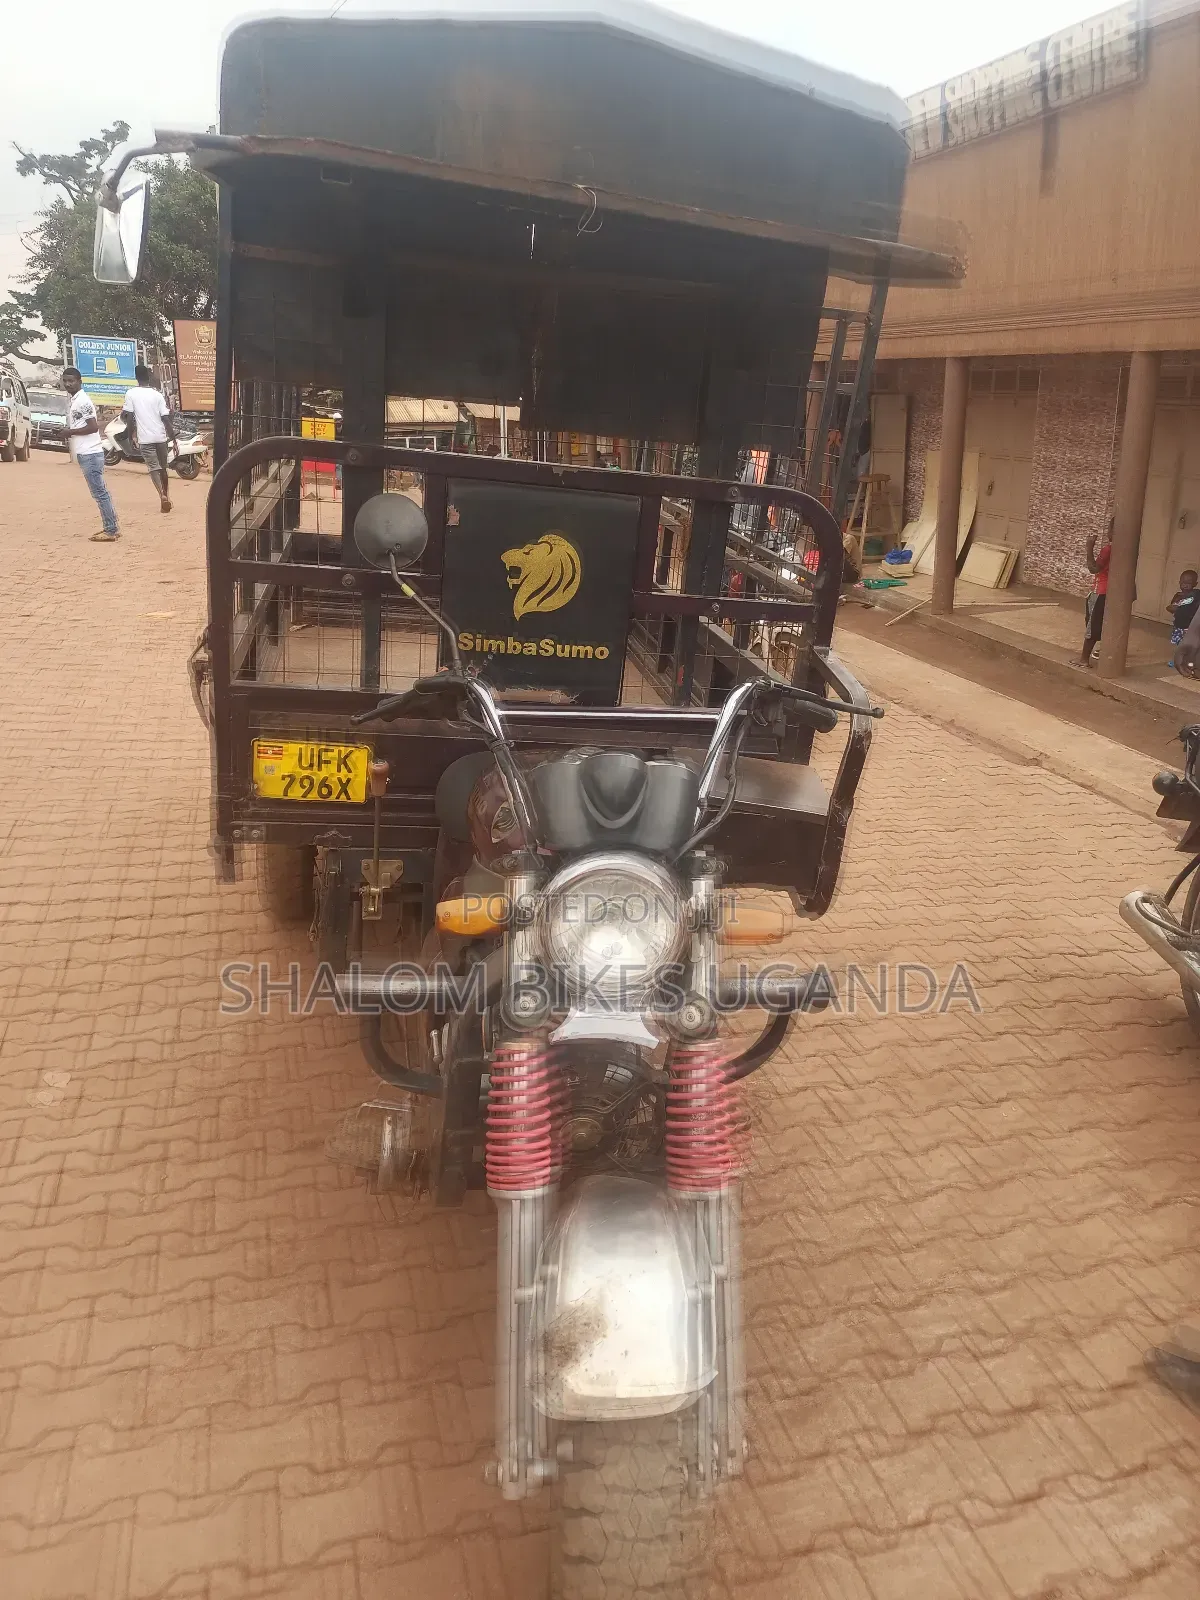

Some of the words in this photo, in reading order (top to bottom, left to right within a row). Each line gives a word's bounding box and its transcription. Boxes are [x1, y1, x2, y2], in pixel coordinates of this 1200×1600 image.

[78, 341, 105, 350] GOLDEN
[106, 343, 131, 352] JUNIOR
[458, 632, 610, 660] SimbaSumo
[298, 746, 354, 773] UFK
[281, 773, 352, 800] 796X
